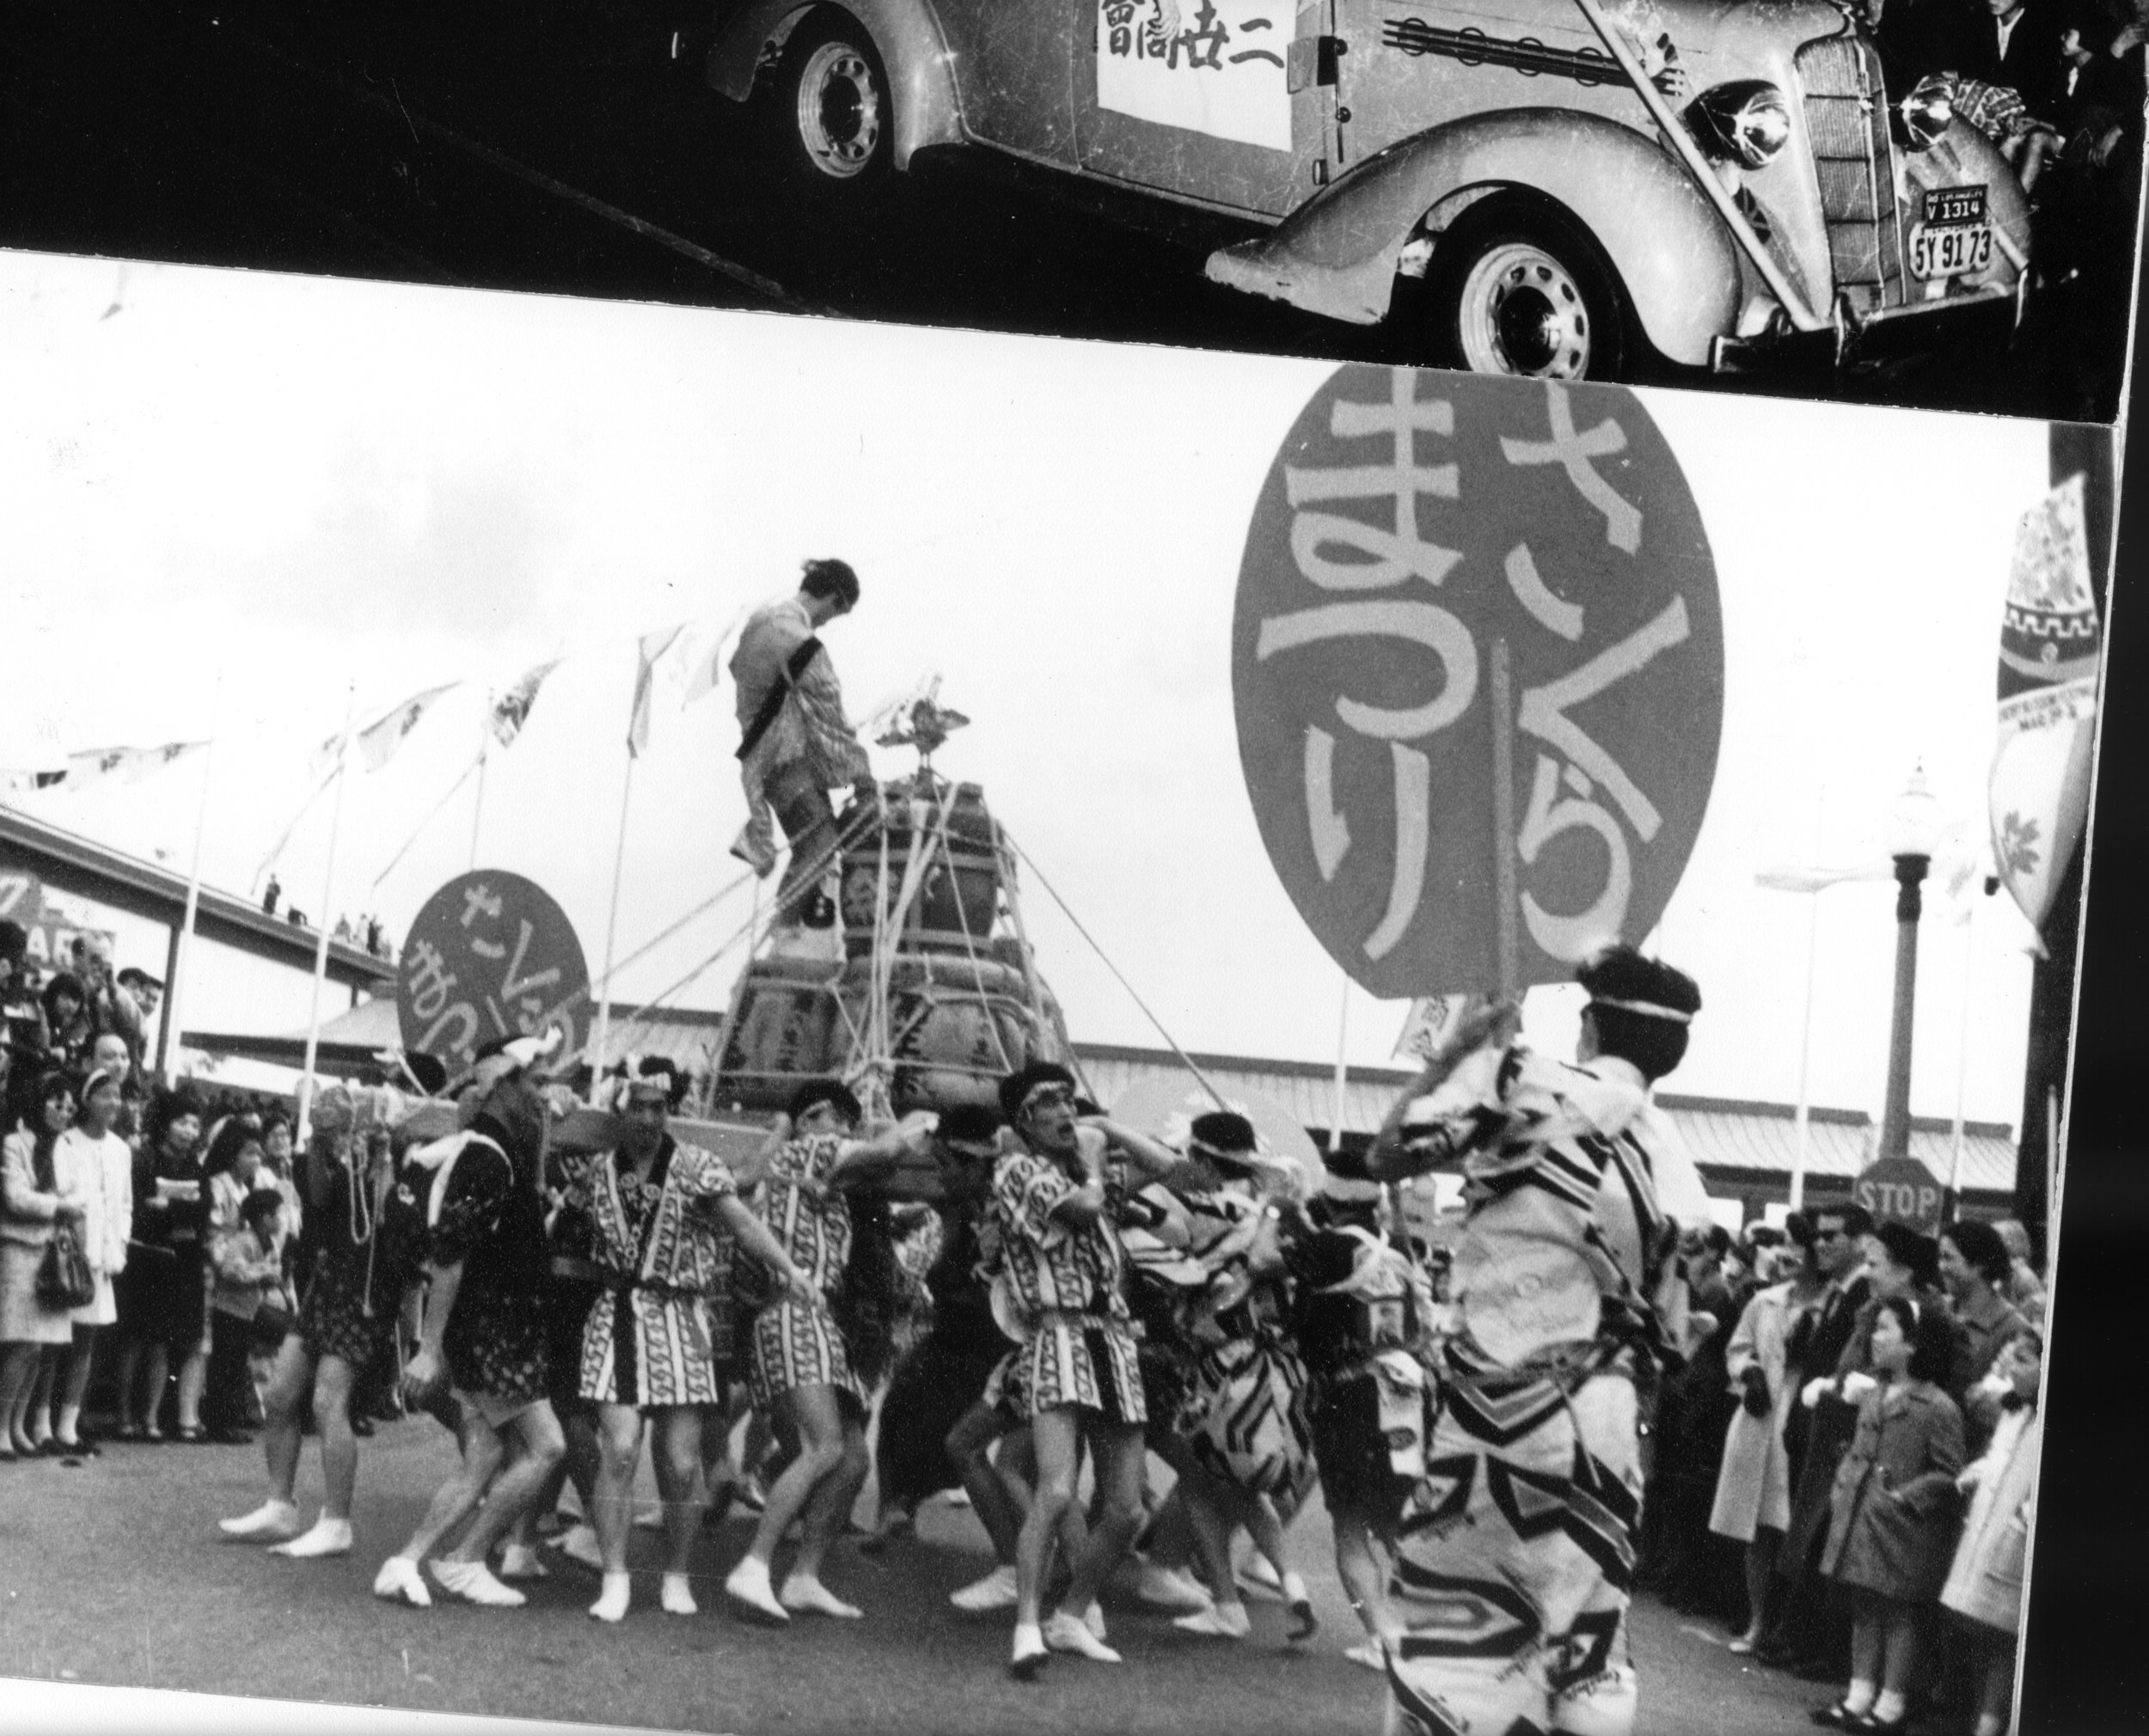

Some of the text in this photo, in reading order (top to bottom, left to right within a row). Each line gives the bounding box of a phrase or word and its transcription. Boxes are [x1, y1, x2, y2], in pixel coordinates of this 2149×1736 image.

[1927, 200, 1980, 220] V 1314
[1916, 229, 1991, 272] 5Y 91 73
[1257, 365, 1479, 961] まつり
[1499, 382, 1691, 965] さくら
[1859, 1180, 1936, 1219] STOP
